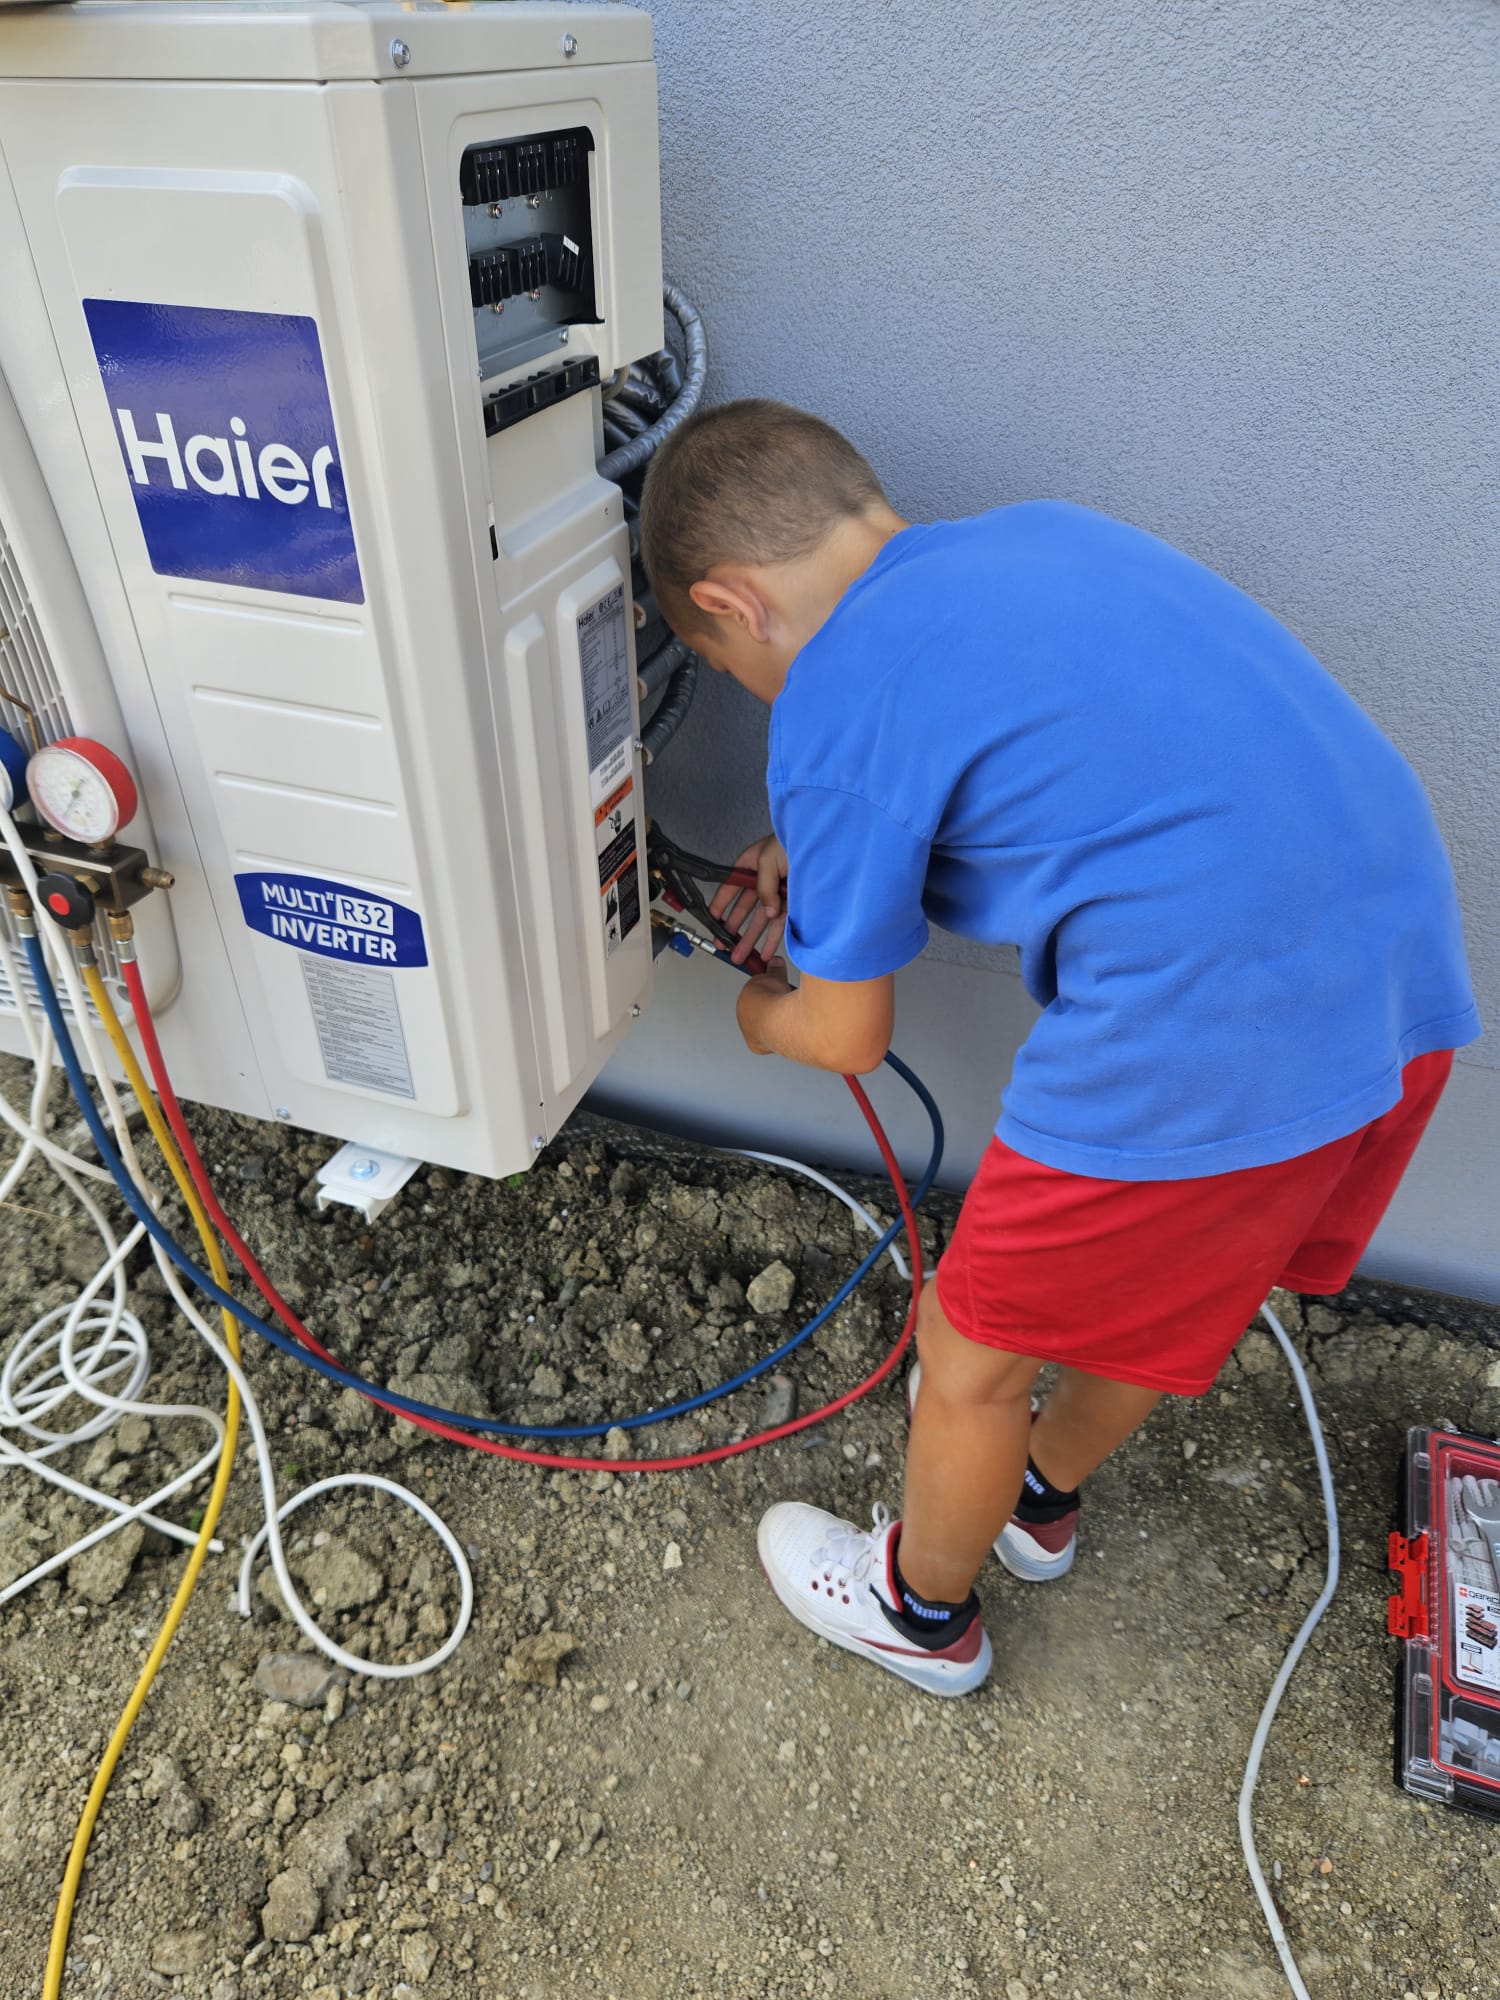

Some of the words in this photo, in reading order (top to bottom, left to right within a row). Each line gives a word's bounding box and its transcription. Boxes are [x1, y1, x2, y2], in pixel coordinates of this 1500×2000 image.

[116, 408, 334, 509] Haier
[342, 897, 390, 930] R32
[271, 914, 398, 962] INVERTER
[1468, 1591, 1500, 1604] QBRIC
